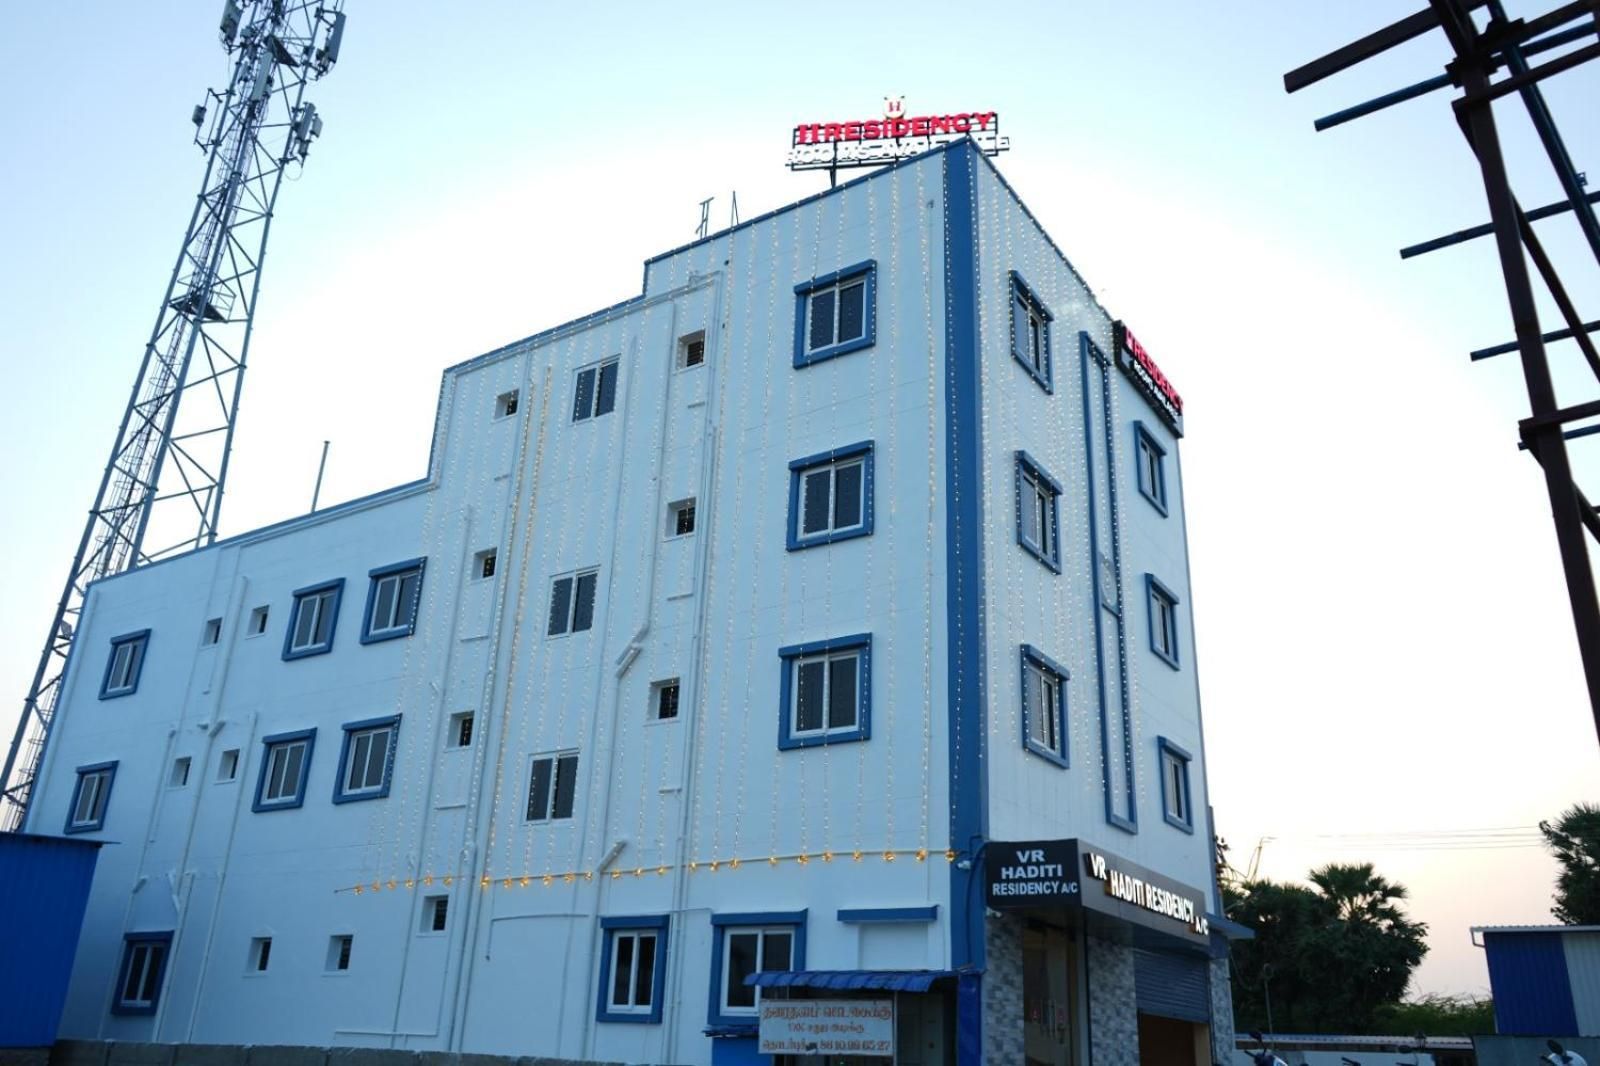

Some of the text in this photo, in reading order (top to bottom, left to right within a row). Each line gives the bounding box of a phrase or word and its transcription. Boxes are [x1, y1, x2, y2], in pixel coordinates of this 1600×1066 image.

[824, 111, 995, 143] RESIDENCY
[1016, 849, 1046, 864] VR
[1001, 864, 1063, 880] HADITI
[992, 882, 1078, 896] RESIDENCY A/C
[1090, 852, 1107, 881] VR
[1110, 869, 1145, 907] HADITI
[1145, 882, 1194, 924] RESIDENCY
